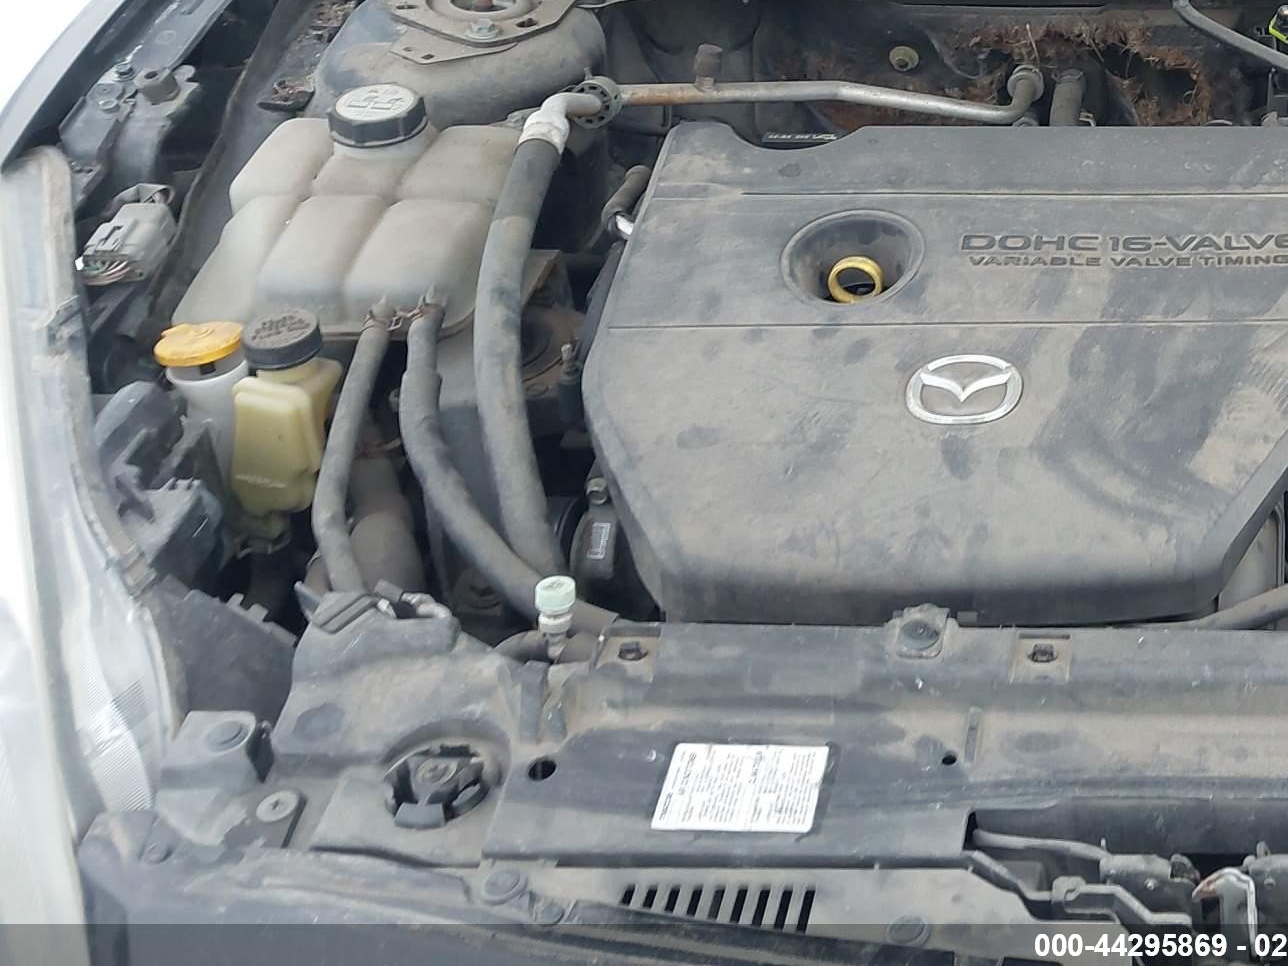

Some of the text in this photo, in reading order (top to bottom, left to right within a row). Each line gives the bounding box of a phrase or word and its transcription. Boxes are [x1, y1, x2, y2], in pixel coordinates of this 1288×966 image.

[961, 234, 1099, 251] DOHC
[968, 255, 1102, 267] VARIABLE
[1110, 256, 1193, 267] VALVE
